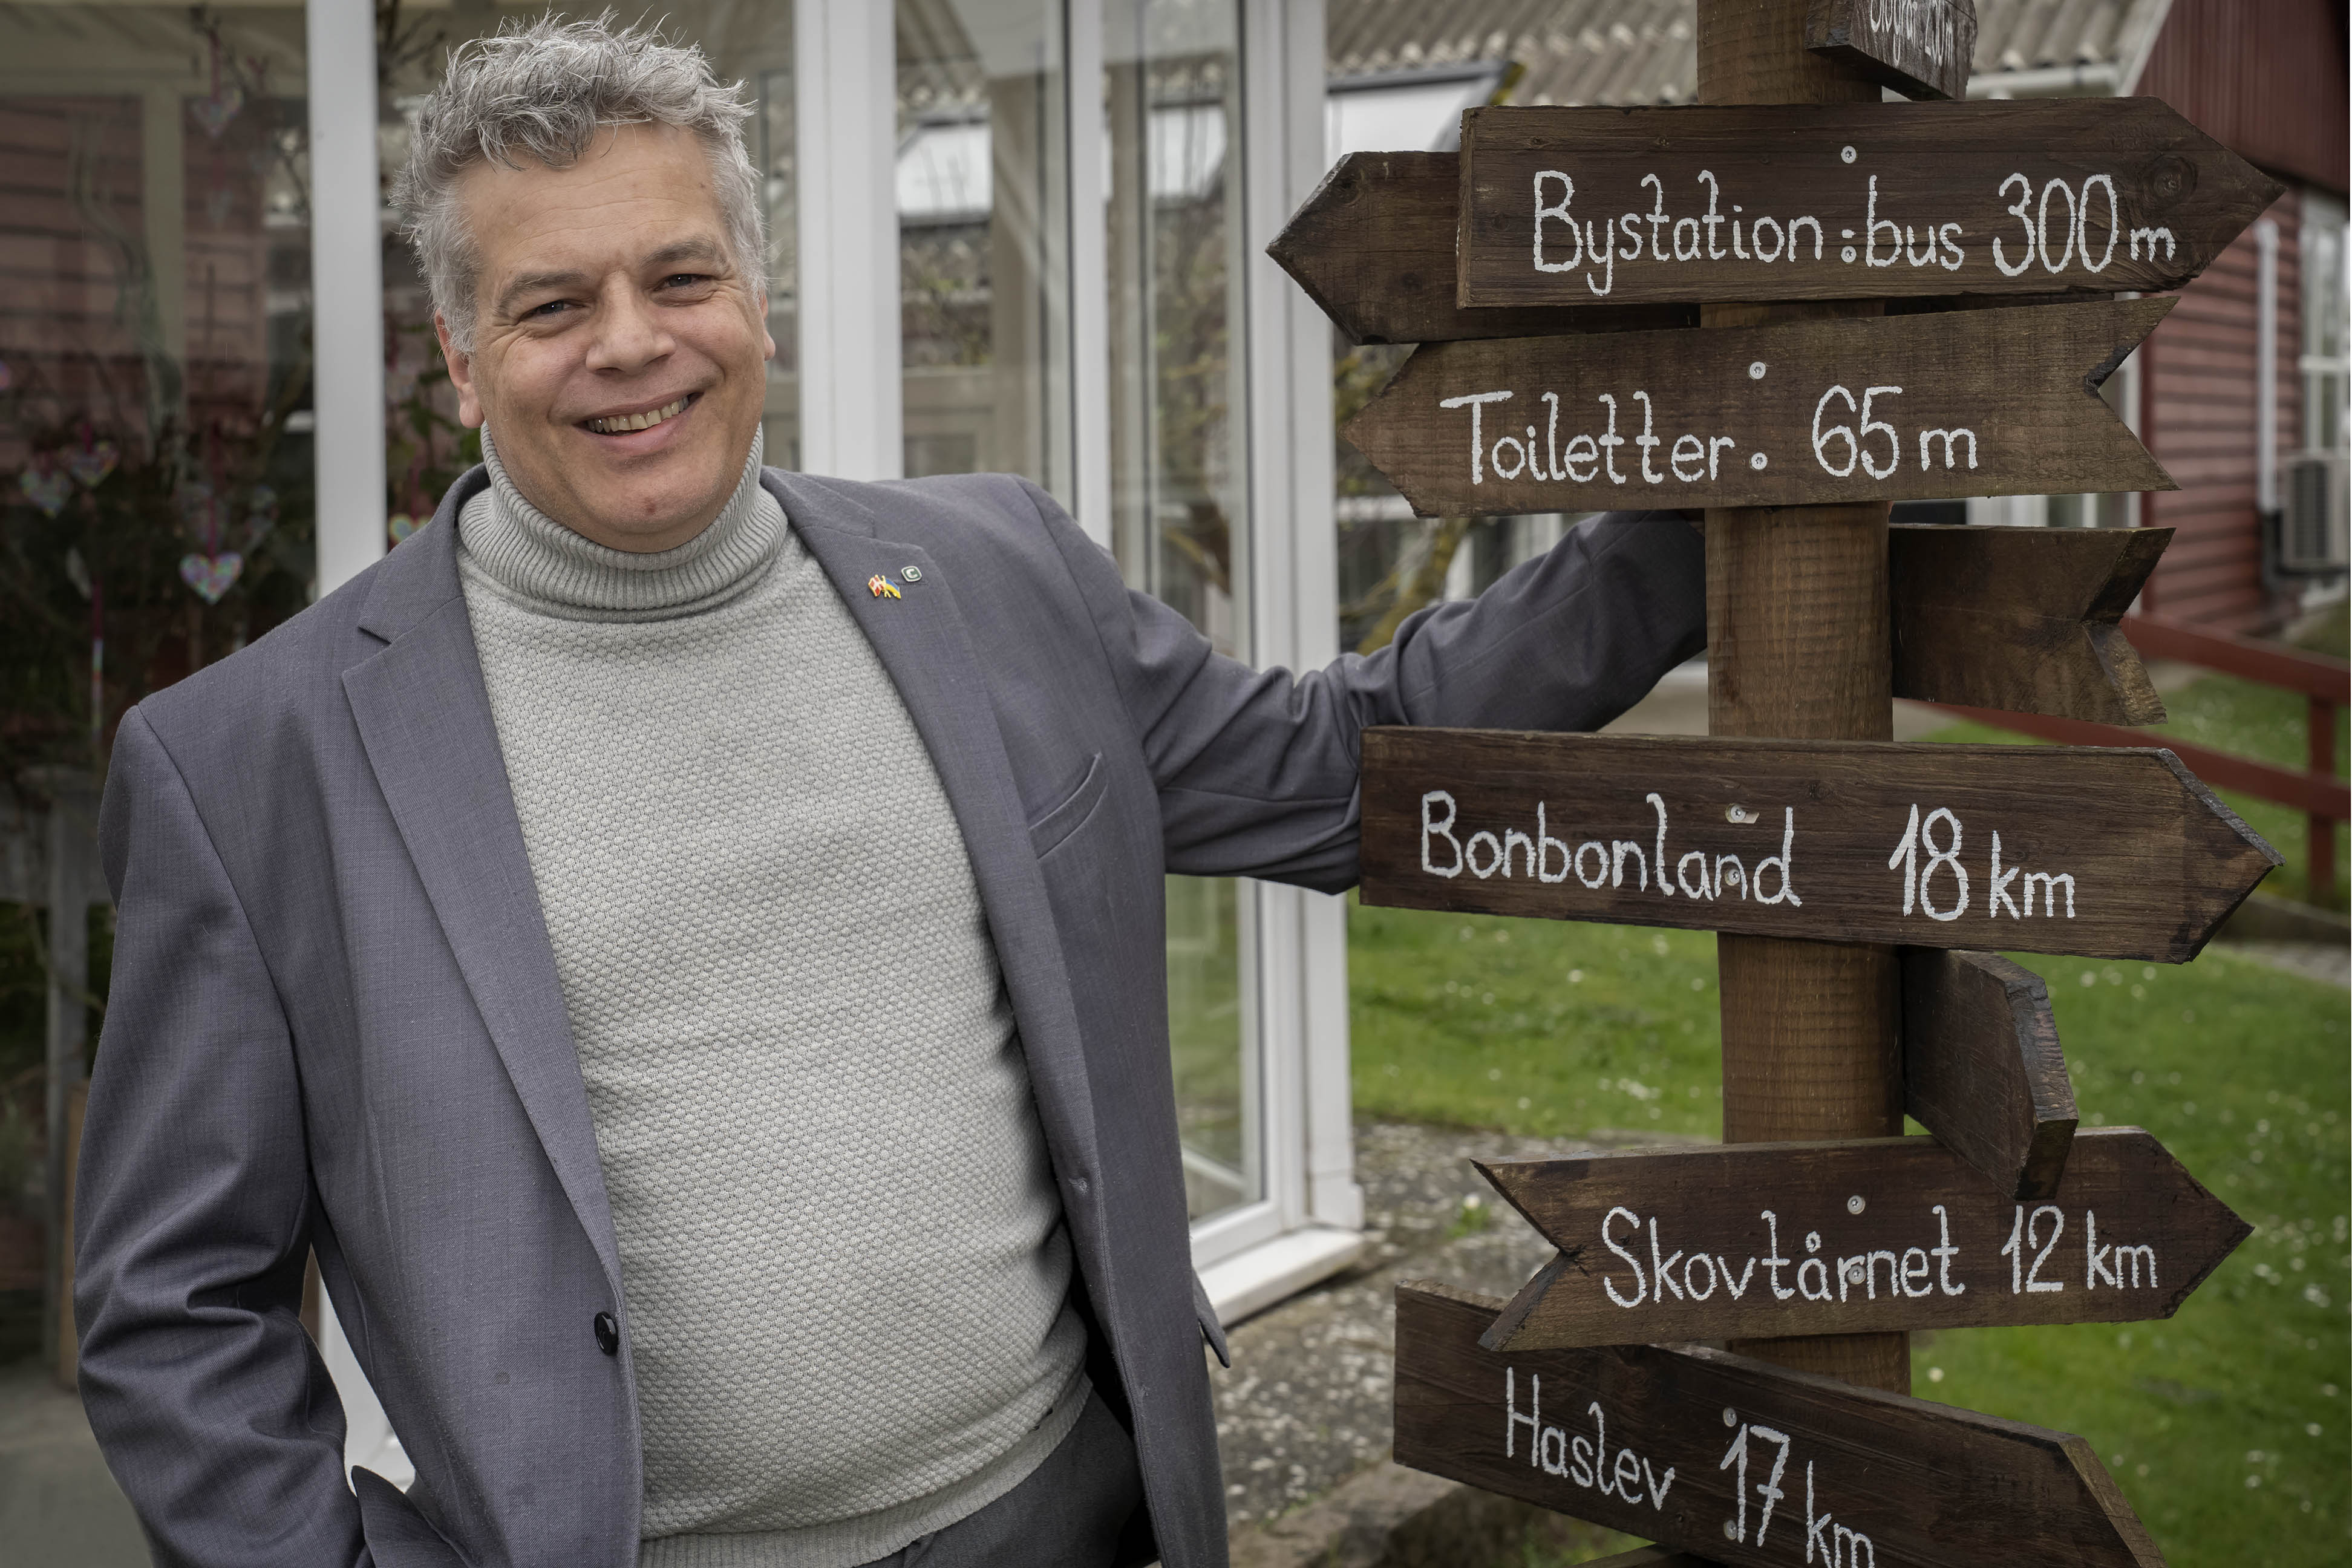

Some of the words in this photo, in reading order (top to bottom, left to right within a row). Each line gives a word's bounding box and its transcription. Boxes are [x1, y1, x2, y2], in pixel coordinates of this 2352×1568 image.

[1993, 173, 2119, 276] 300
[2131, 227, 2176, 262] m
[1812, 385, 1903, 480] 65
[1919, 428, 1978, 471] m
[1422, 791, 1802, 907] Bonbonland
[1889, 804, 1970, 921] 18
[1990, 831, 2076, 920] km
[1602, 1205, 1965, 1308] Skovtårnet
[2002, 1206, 2064, 1294] 12
[2087, 1210, 2158, 1290] km
[1507, 1367, 1674, 1511] Haslev
[1721, 1424, 1790, 1546] 17
[1806, 1461, 1875, 1568] km
